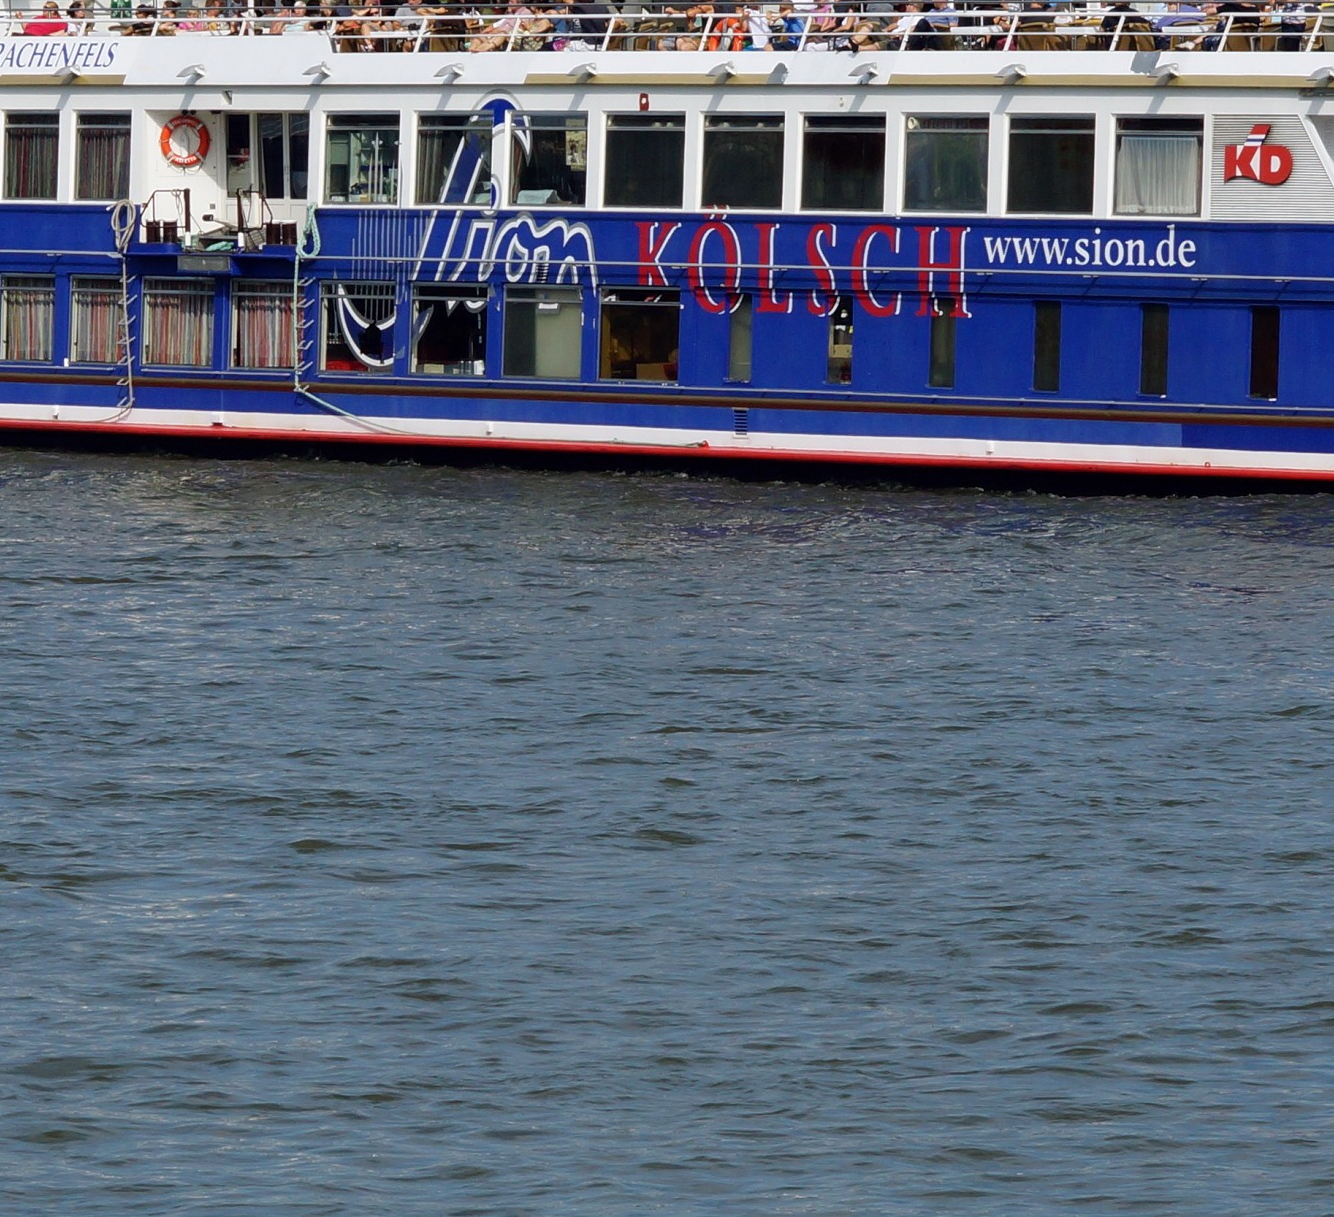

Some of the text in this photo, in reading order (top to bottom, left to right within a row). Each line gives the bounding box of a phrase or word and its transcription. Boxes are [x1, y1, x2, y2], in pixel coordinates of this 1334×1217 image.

[1224, 142, 1293, 186] KD
[635, 205, 973, 319] KÖLSCH
[983, 223, 1196, 268] www.sion.de
